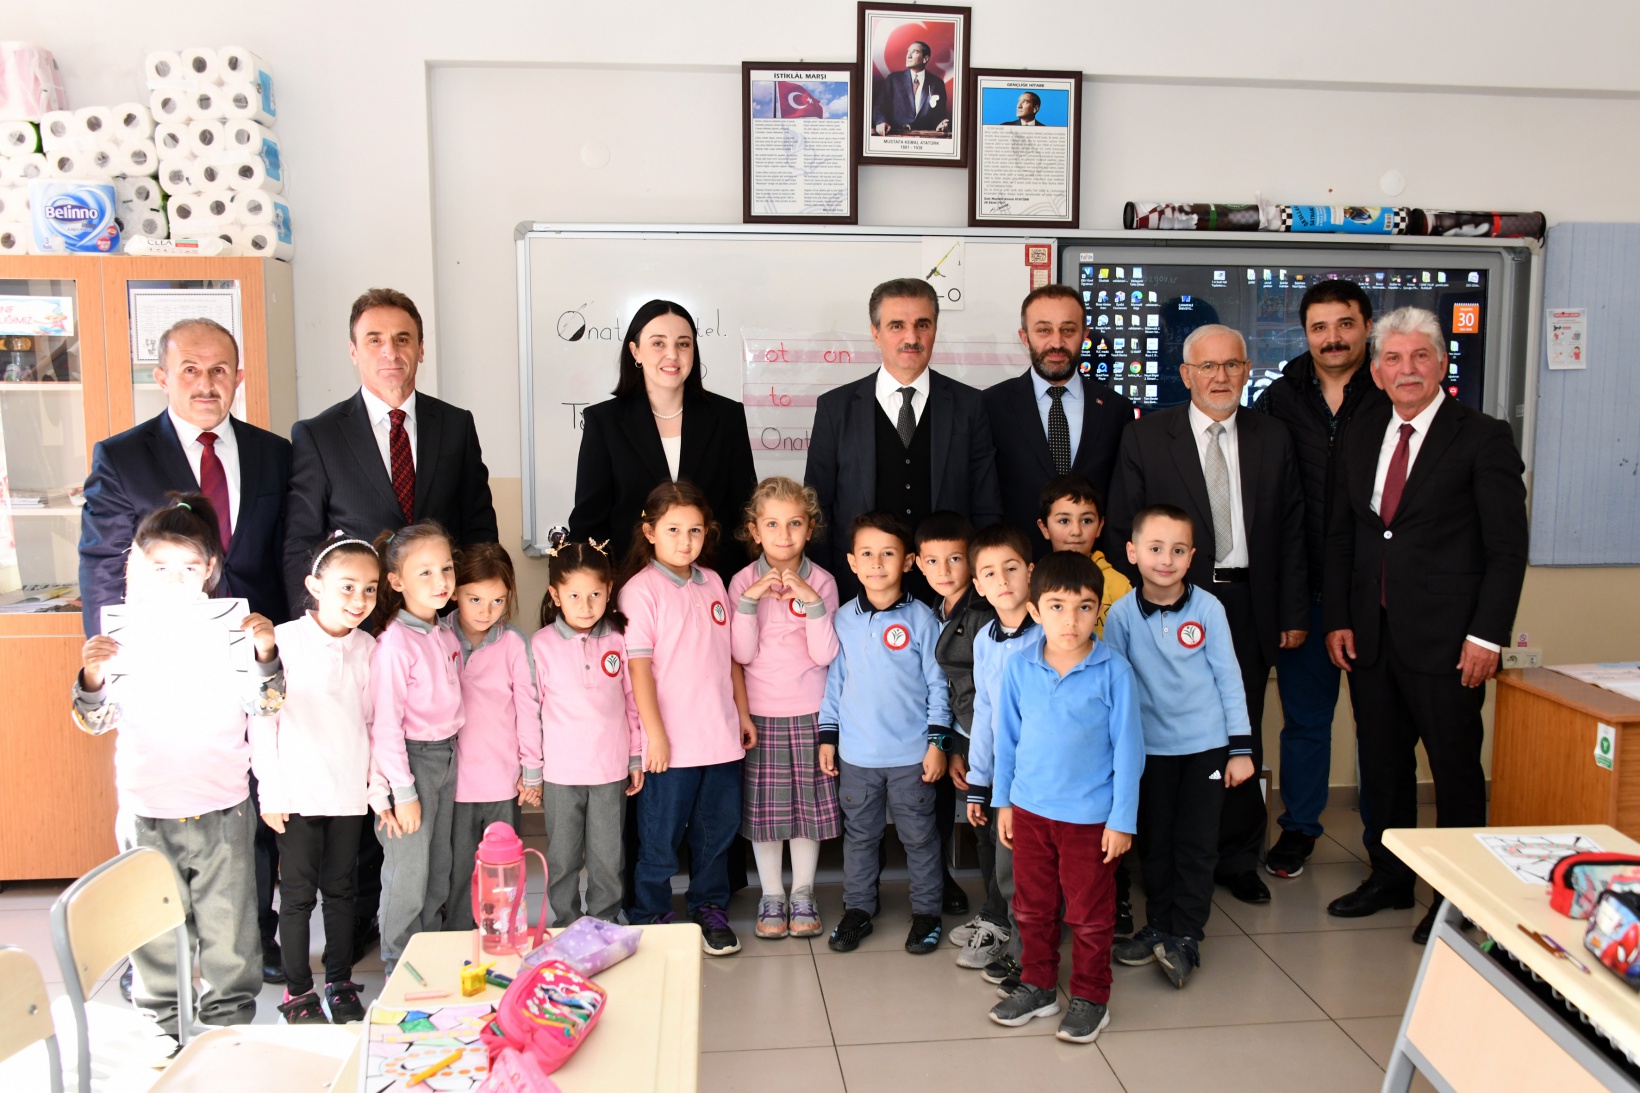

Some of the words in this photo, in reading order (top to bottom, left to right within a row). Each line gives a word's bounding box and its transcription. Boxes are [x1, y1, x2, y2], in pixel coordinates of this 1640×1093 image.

[45, 205, 98, 220] Belinno
[1458, 313, 1474, 326] 30
[766, 342, 789, 362] ot
[824, 350, 851, 363] on
[770, 386, 791, 407] to
[761, 427, 811, 451] Onat
